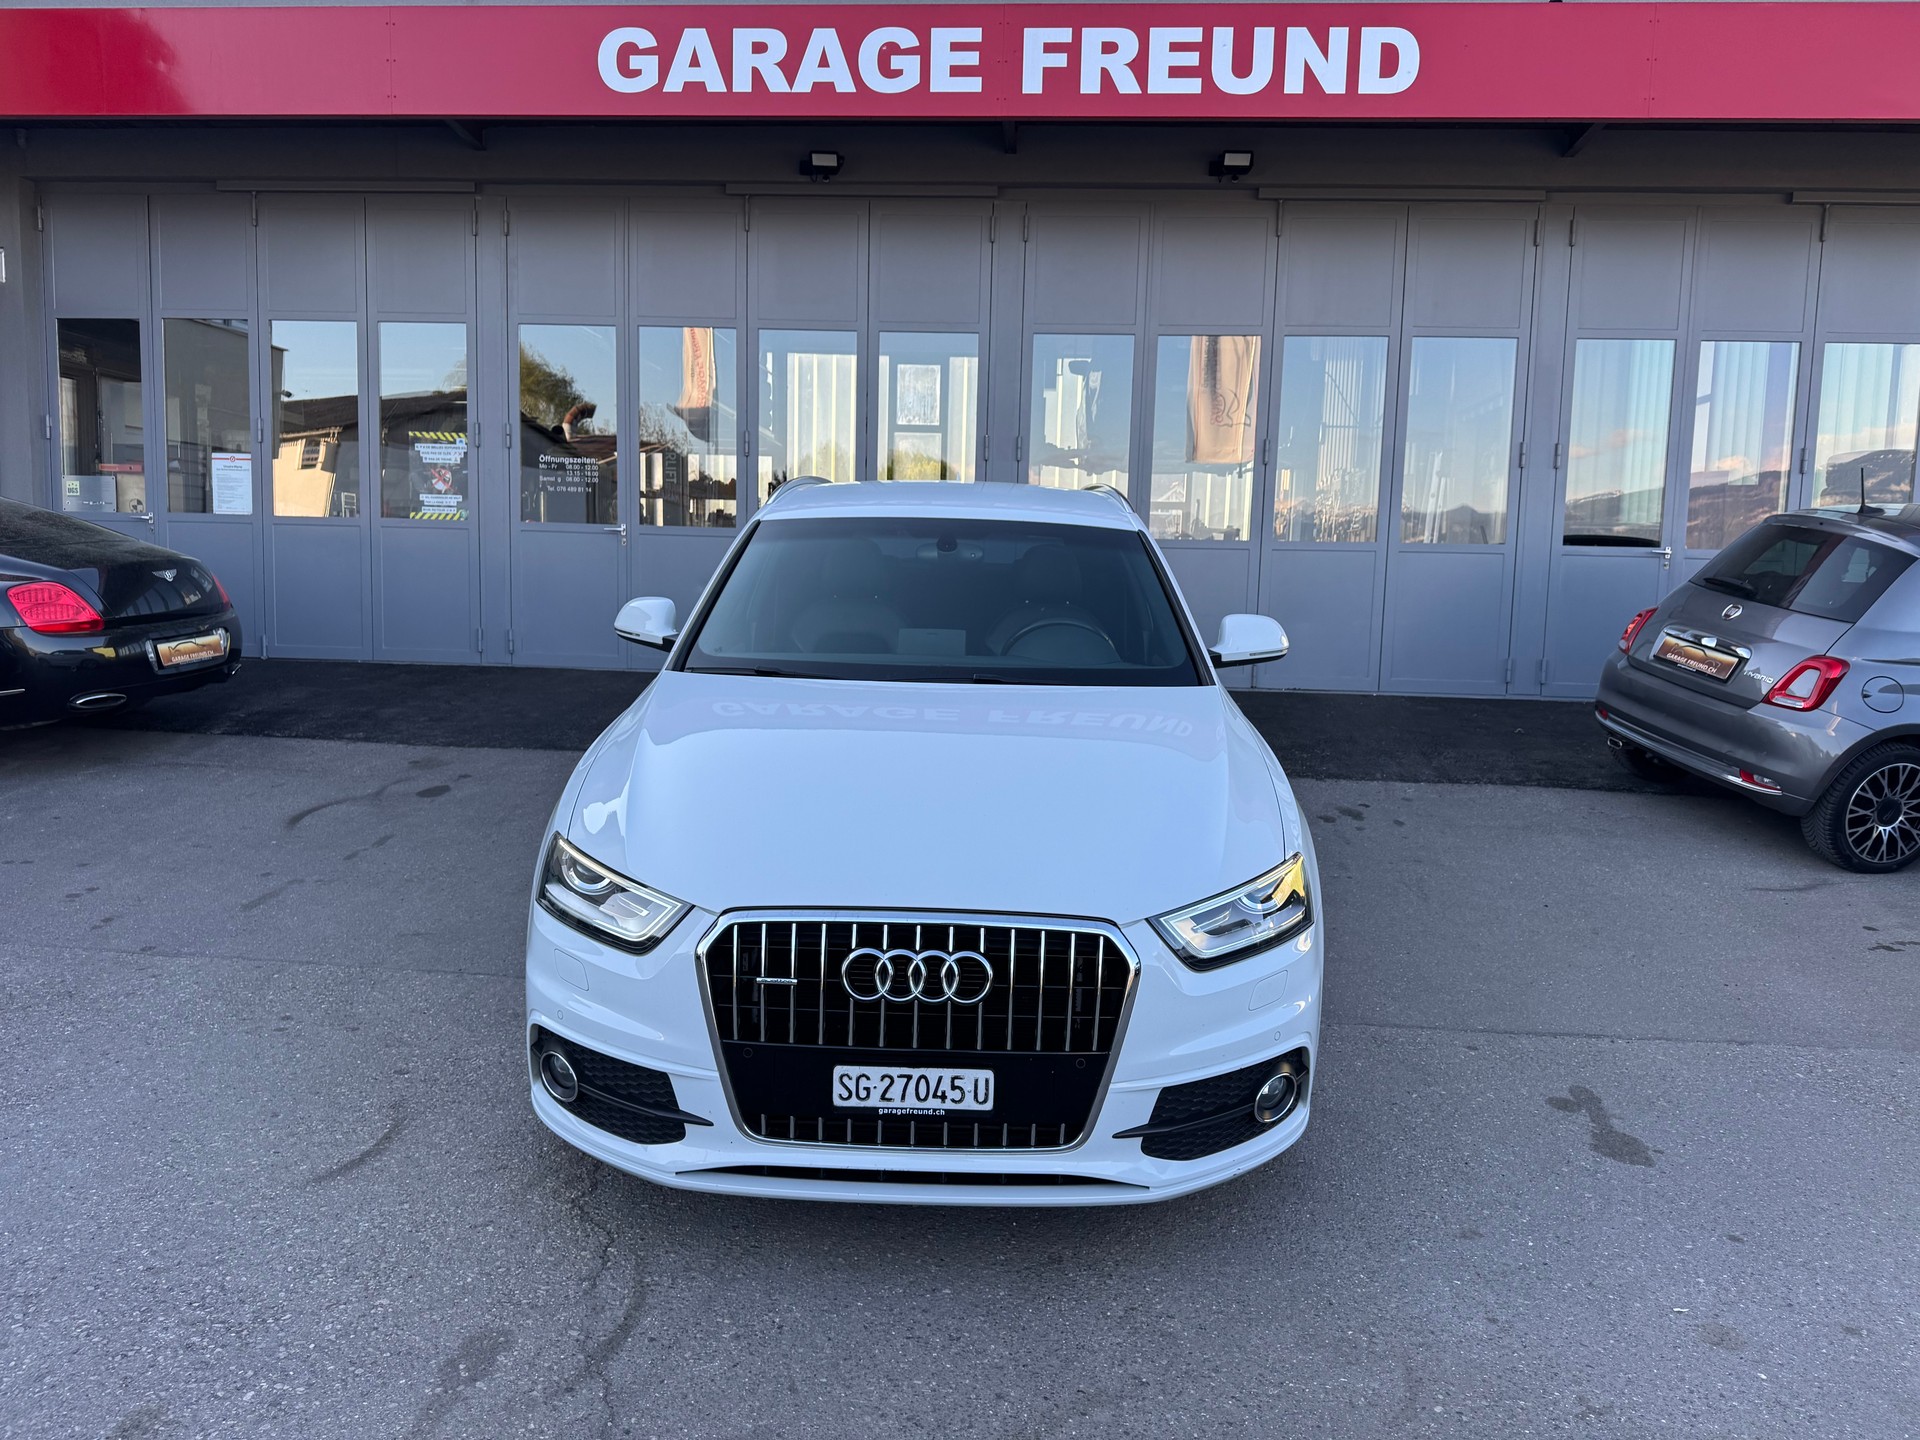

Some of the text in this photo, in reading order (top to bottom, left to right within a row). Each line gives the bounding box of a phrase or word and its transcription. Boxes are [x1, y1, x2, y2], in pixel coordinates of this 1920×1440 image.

[597, 26, 1421, 95] GARAGE FREUND
[539, 454, 598, 465] Öffnungszeiten:
[1666, 652, 1688, 664] GARAGE
[1687, 659, 1718, 674] FREUND.CH
[878, 1108, 946, 1116] garagefreund.ch
